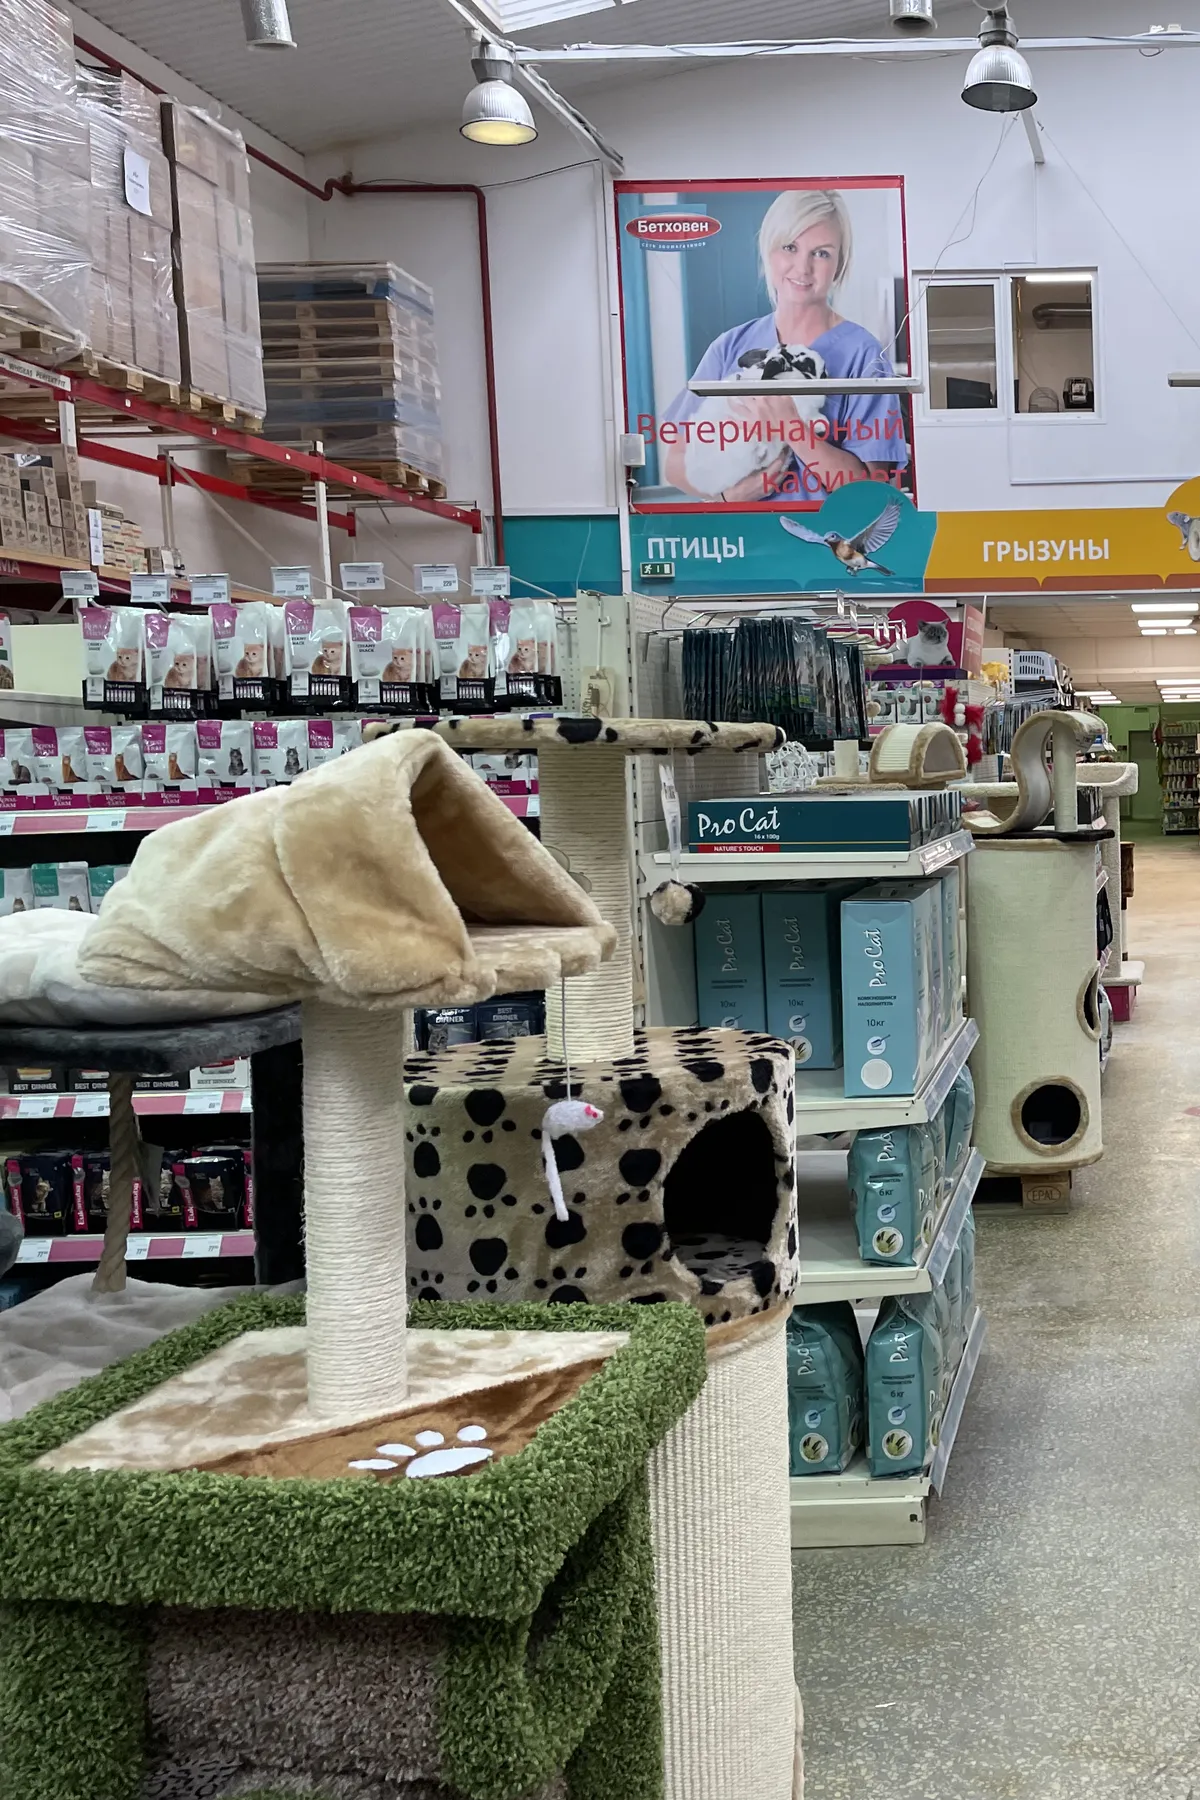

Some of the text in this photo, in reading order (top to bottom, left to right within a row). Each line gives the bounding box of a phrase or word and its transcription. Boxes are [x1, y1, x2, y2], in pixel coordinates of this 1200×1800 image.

[637, 220, 709, 233] Бетховен
[636, 409, 904, 451] Ветеринарный
[647, 536, 745, 563] ПТИЦЫ
[982, 539, 1110, 562] ГРЫЗУНЫ
[697, 806, 781, 838] Pro Cat
[716, 917, 733, 945] Cat
[784, 915, 800, 943] Cat
[721, 946, 738, 972] Pro
[789, 945, 805, 971] Pro
[863, 927, 887, 988] Pro Cat
[13, 1083, 28, 1091] BEST
[75, 1185, 85, 1226] Eukanuba
[132, 1182, 140, 1224] Eukanuba
[797, 1347, 816, 1376] Pro
[890, 1332, 909, 1363] Pro
